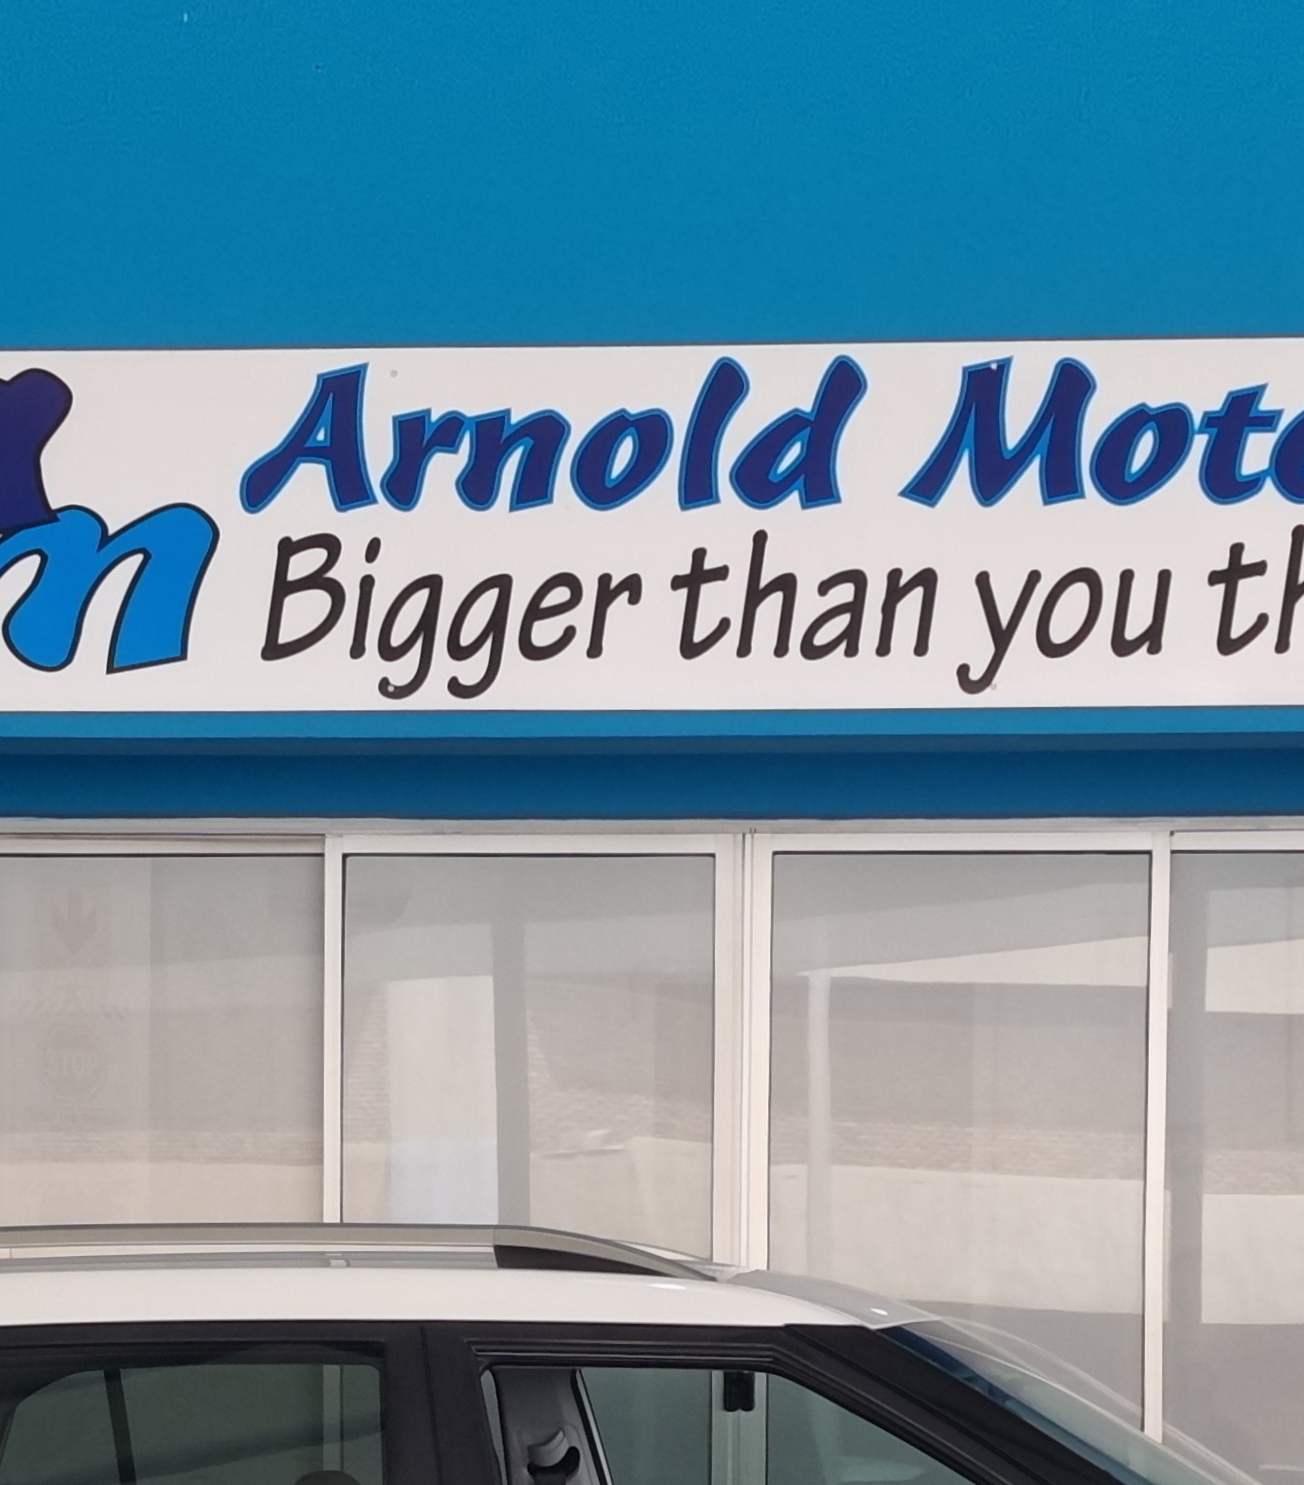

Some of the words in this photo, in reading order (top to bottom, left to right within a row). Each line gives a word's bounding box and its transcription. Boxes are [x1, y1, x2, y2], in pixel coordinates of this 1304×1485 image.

[239, 355, 867, 514] Arnold
[260, 533, 642, 700] Bigger
[669, 528, 938, 661] than
[956, 567, 1173, 695] you
